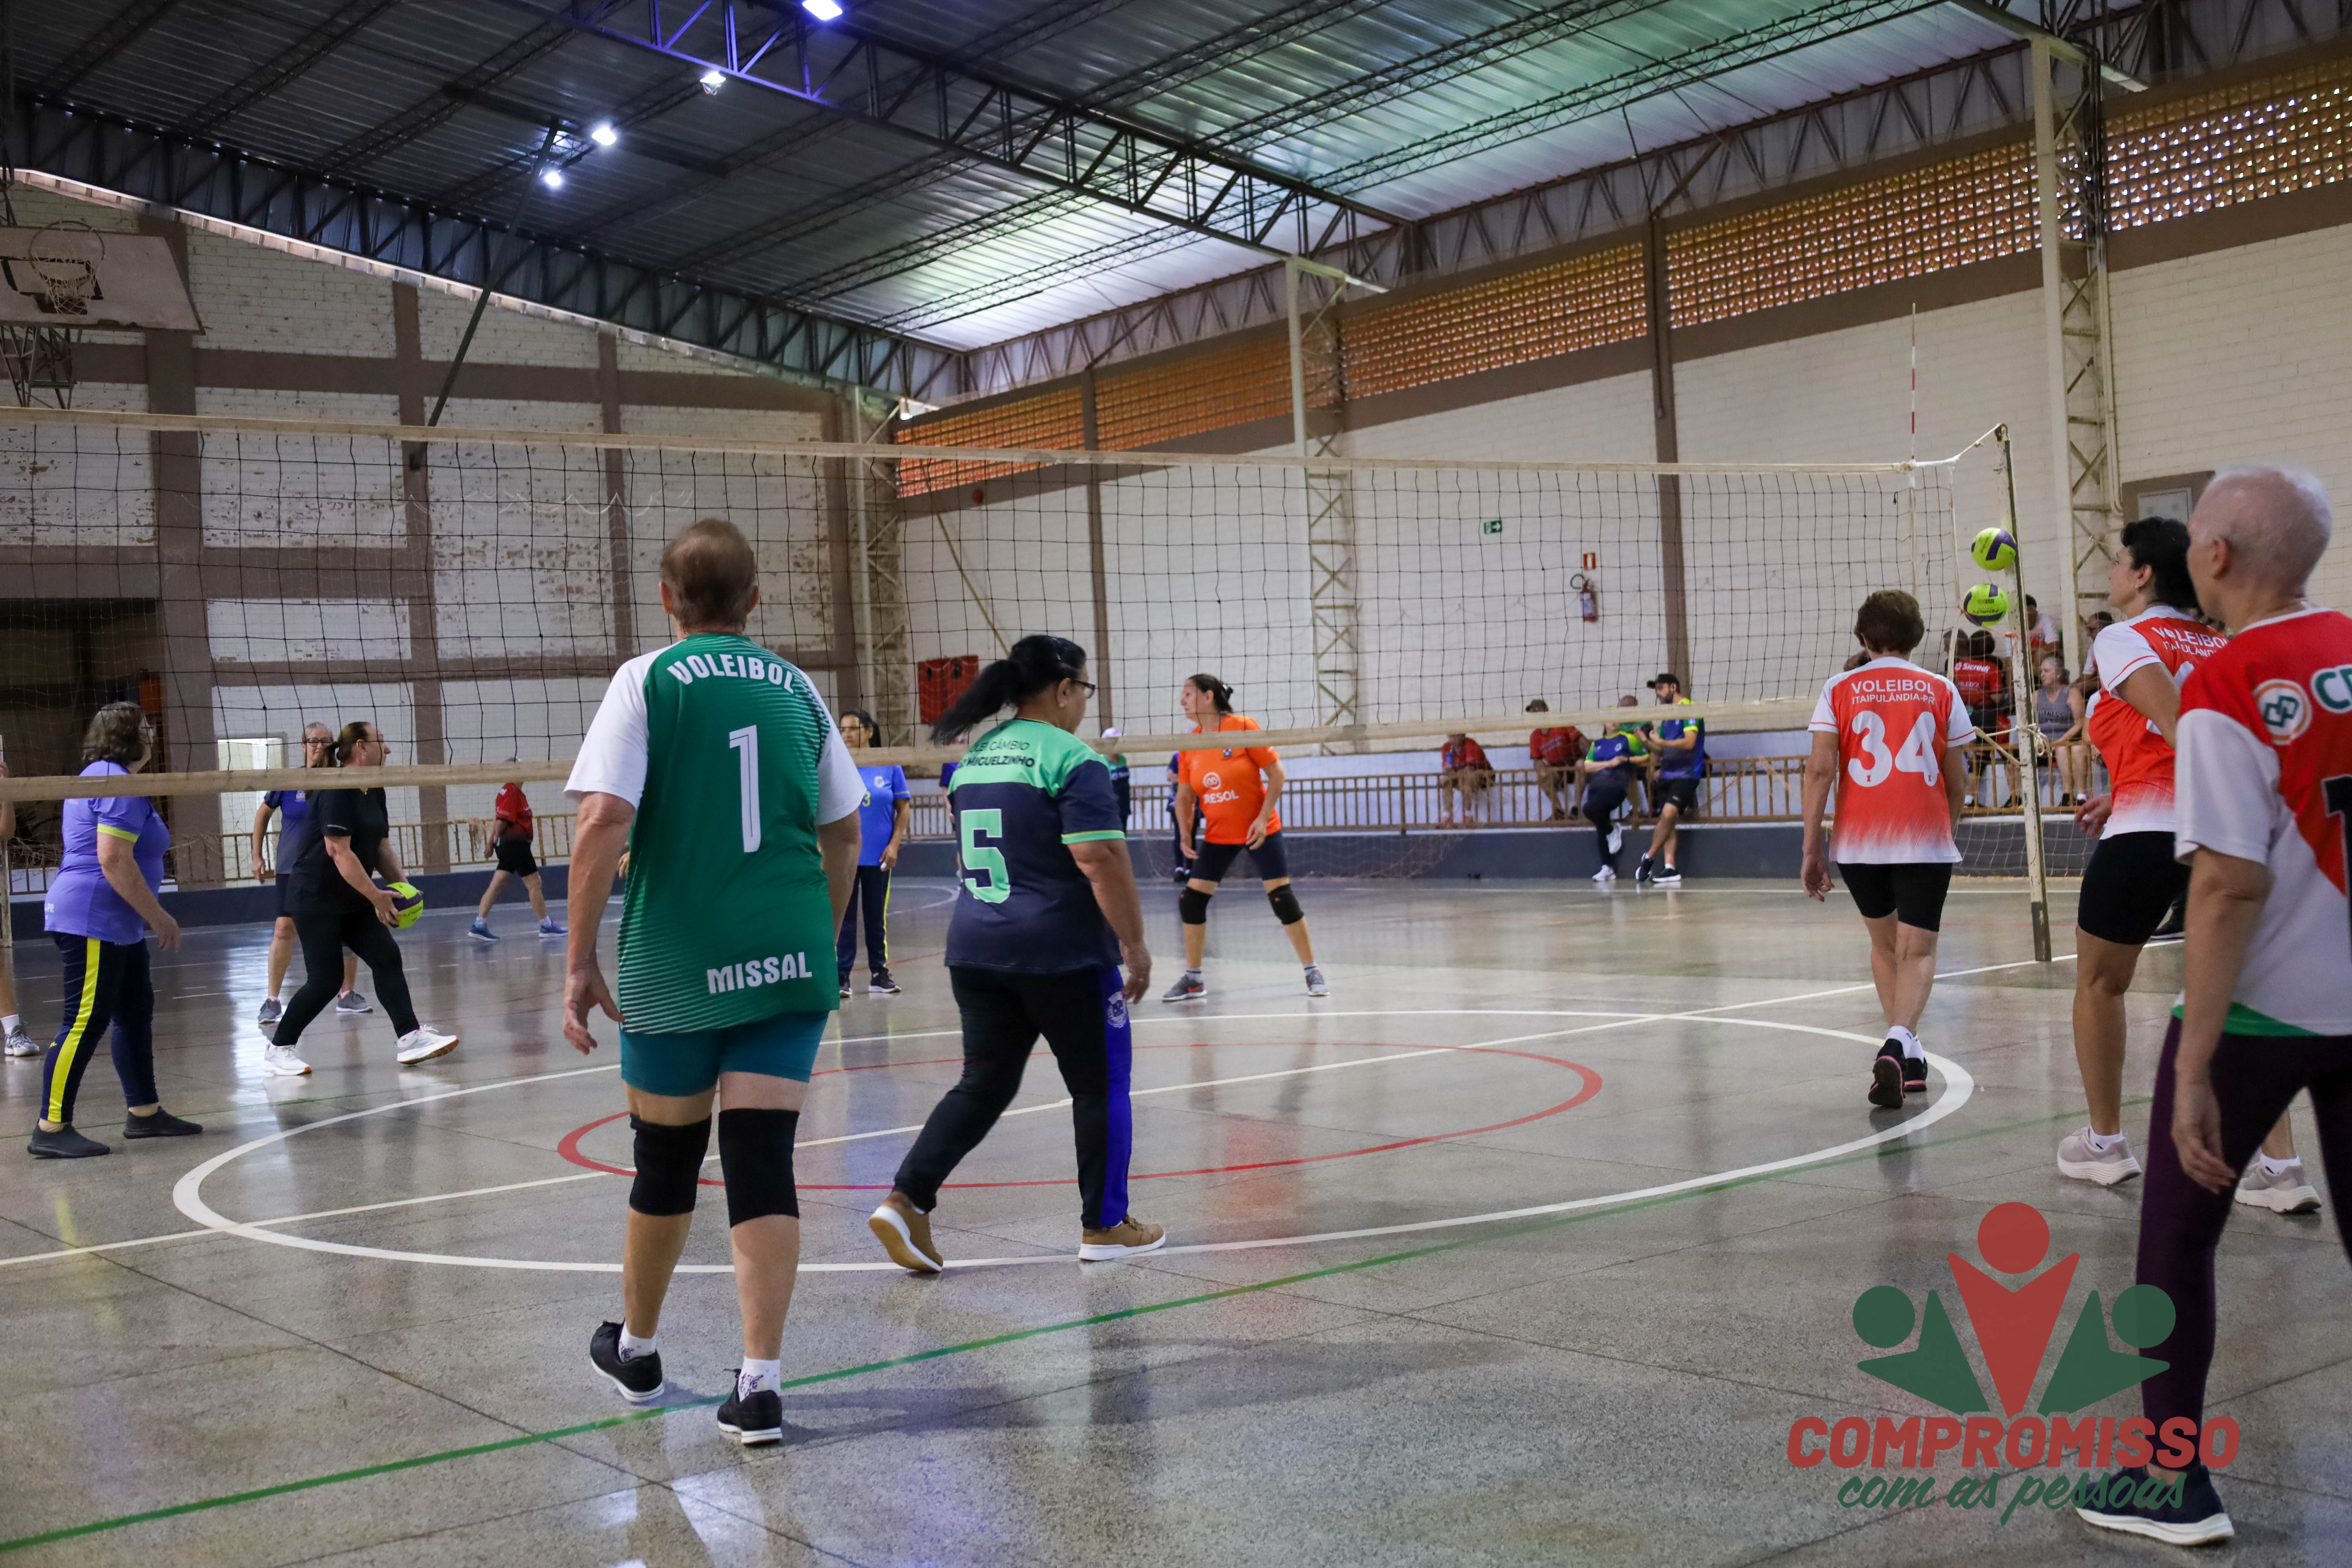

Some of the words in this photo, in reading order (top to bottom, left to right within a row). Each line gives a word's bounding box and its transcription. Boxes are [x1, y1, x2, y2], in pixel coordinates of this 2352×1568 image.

[667, 654, 794, 694] VOLEIBOL
[1851, 680, 1934, 695] VOLEIBOL
[1848, 710, 1939, 787] 34
[729, 725, 761, 853] 1
[961, 808, 1011, 903] 5
[707, 952, 812, 994] MISSAL
